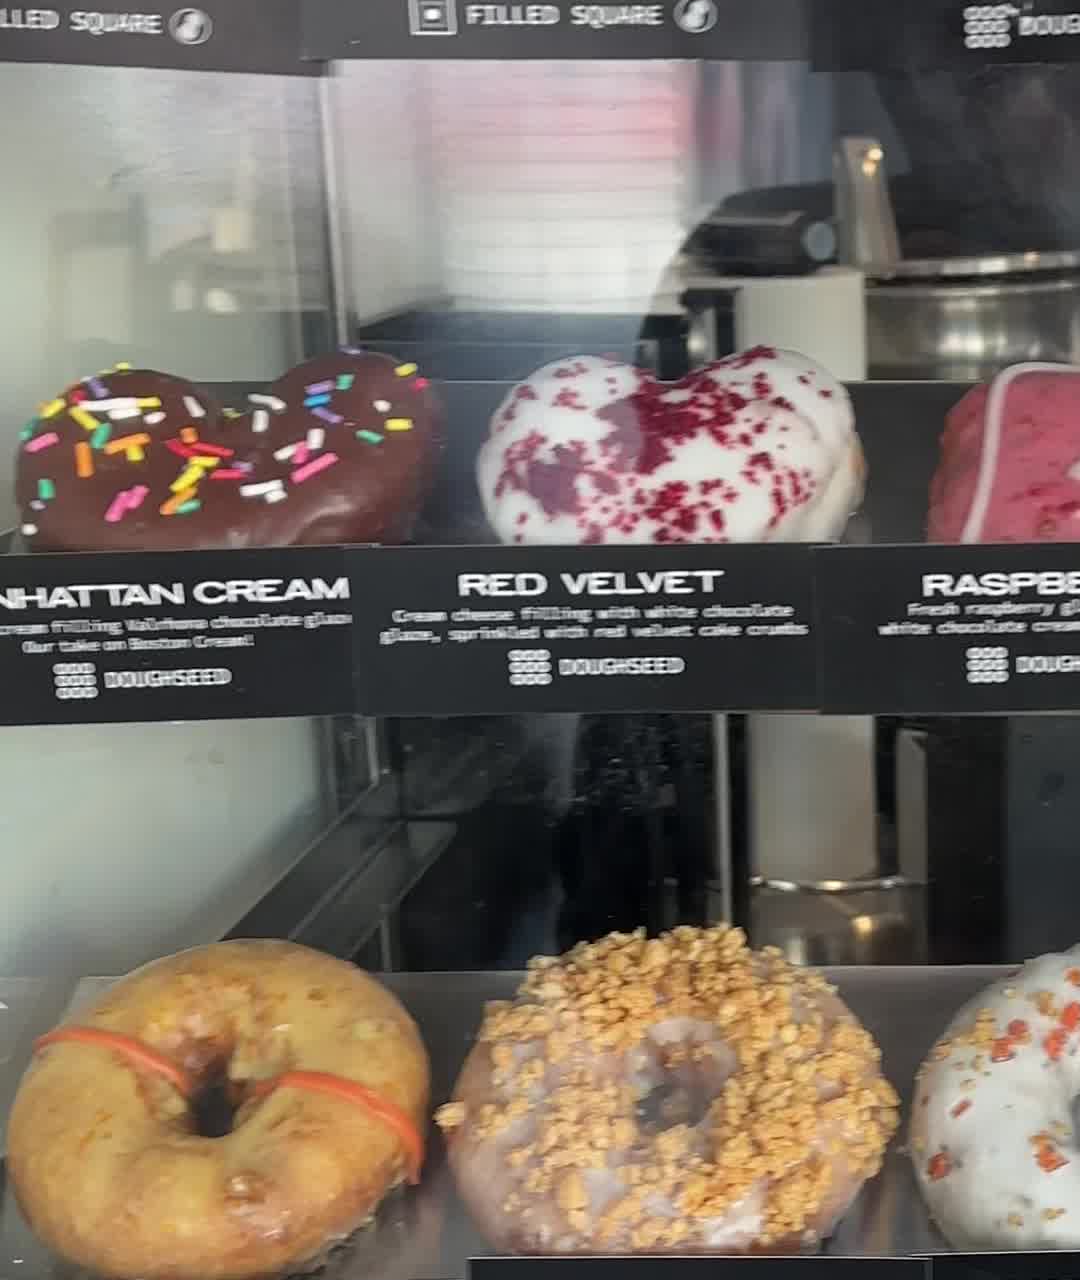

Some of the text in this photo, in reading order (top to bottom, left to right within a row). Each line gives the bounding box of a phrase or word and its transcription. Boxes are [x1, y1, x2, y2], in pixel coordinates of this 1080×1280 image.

[70, 11, 163, 35] SQUARE
[466, 5, 665, 28] FILLED SQUARE
[193, 577, 350, 605] CREAM
[457, 570, 725, 596] RED VELVET
[104, 669, 232, 688] DOUGHSEED
[559, 658, 685, 676] DOUGHSEED
